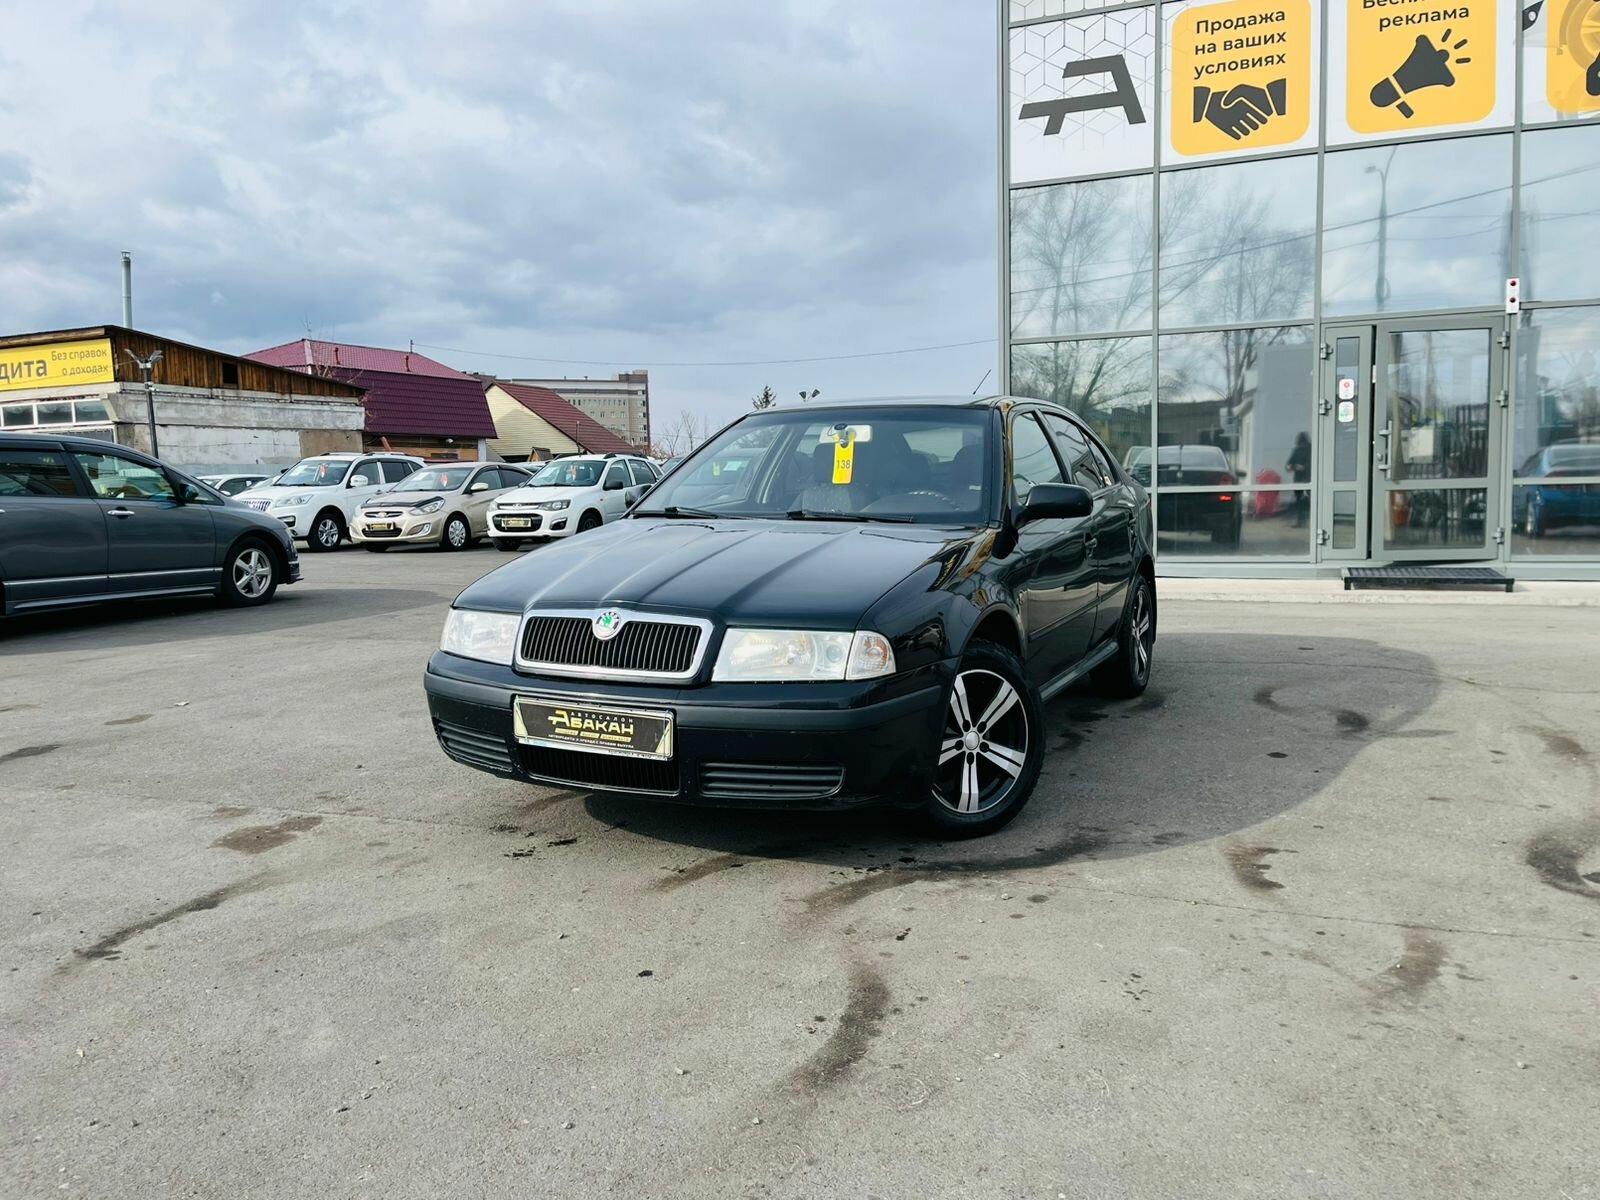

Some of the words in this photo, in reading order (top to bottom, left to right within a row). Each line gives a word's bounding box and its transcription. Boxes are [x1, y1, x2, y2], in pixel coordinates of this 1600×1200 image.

[1196, 10, 1286, 35] Продажа
[1379, 6, 1470, 32] реклама
[1194, 42, 1217, 56] на
[1223, 31, 1287, 52] ваших
[1194, 53, 1287, 80] условиях
[51, 350, 68, 361] Без
[69, 348, 108, 361] справок
[62, 367, 68, 376] о
[70, 364, 109, 376] доходах
[837, 459, 851, 470] 138
[570, 711, 634, 723] АВТОСАЛОН
